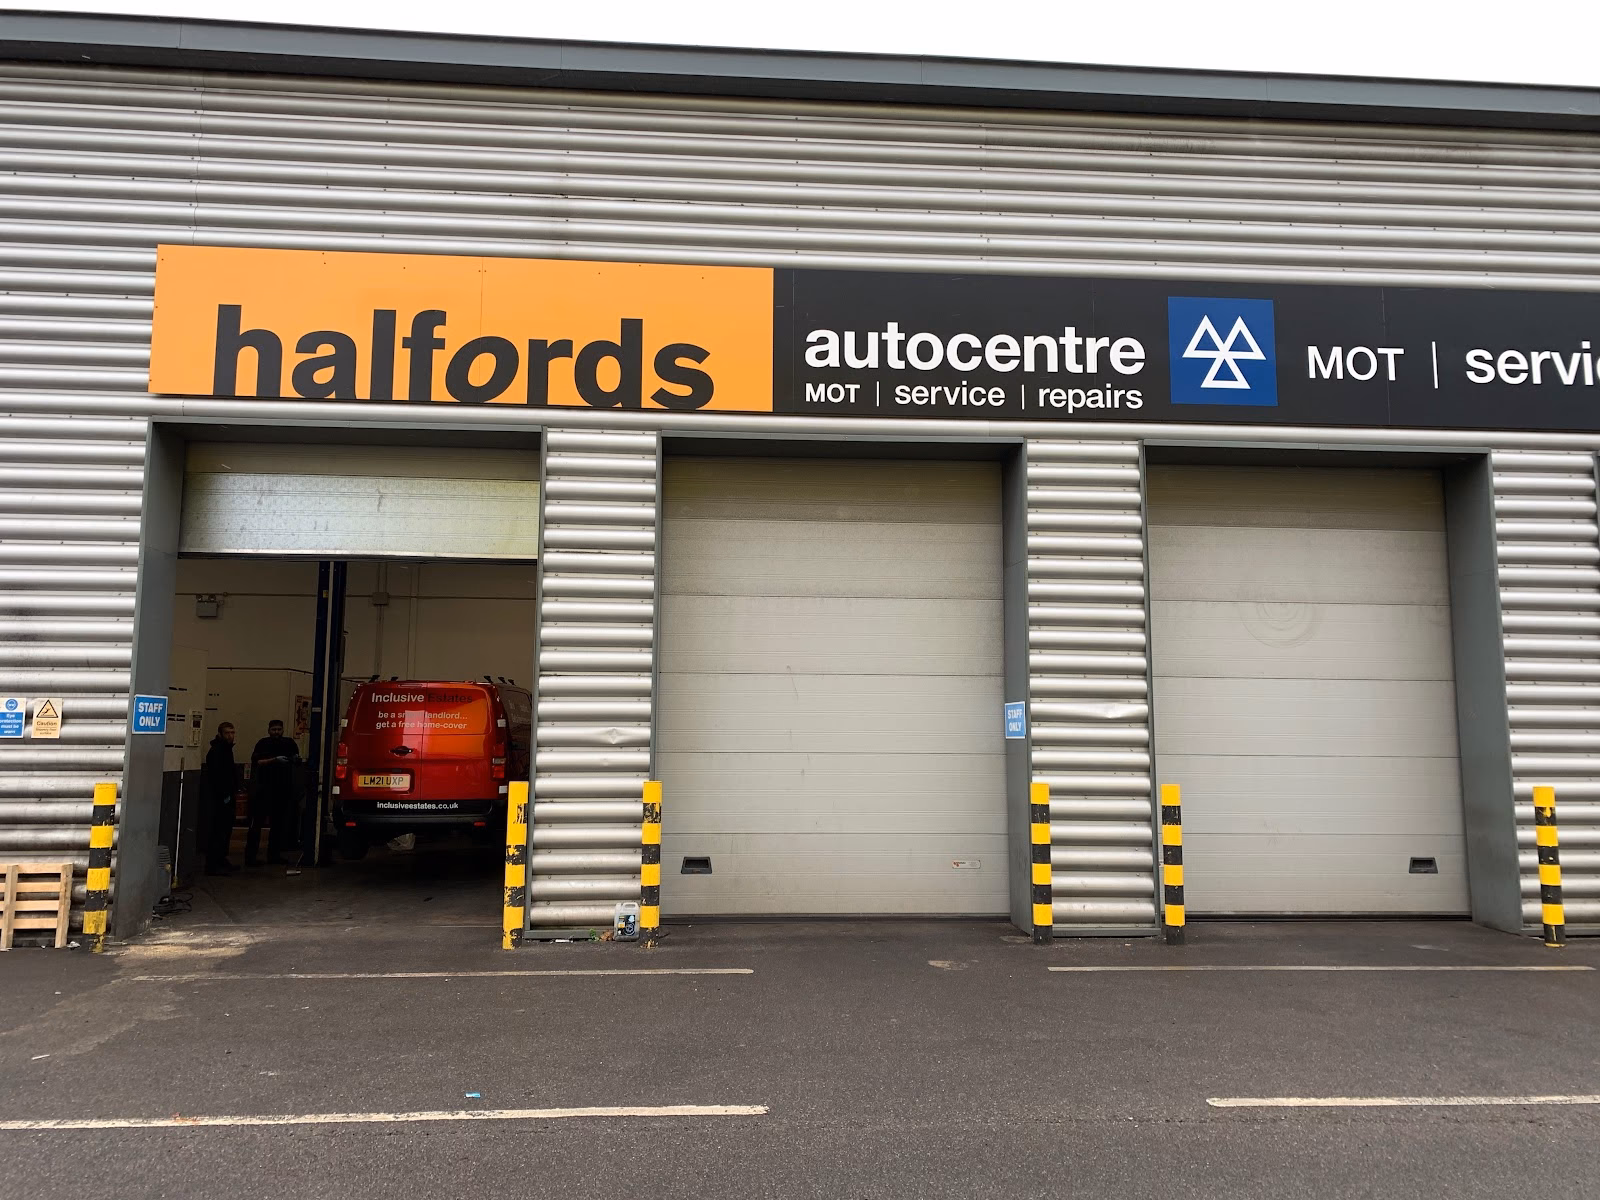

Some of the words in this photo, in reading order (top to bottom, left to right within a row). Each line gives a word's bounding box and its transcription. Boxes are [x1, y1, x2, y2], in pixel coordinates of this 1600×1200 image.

[804, 322, 1146, 375] autocentre
[213, 304, 715, 411] halfords
[1307, 345, 1405, 381] MOT
[1465, 341, 1600, 386] servi
[805, 382, 860, 403] MOT
[894, 381, 1006, 407] service
[1038, 383, 1144, 414] repairs
[371, 692, 425, 703] Inclusive
[427, 693, 473, 703] Estates
[138, 702, 163, 713] STAFF
[378, 711, 389, 719] be
[1007, 709, 1023, 719] STAFF
[139, 716, 161, 727] ONLY
[375, 721, 390, 729] get
[398, 720, 416, 728] free
[417, 720, 468, 729] home-cover
[1008, 722, 1022, 732] ONLY
[363, 776, 384, 785] LM21
[386, 776, 404, 786] UXP
[376, 801, 459, 810] inclusiveestates.co.uk
